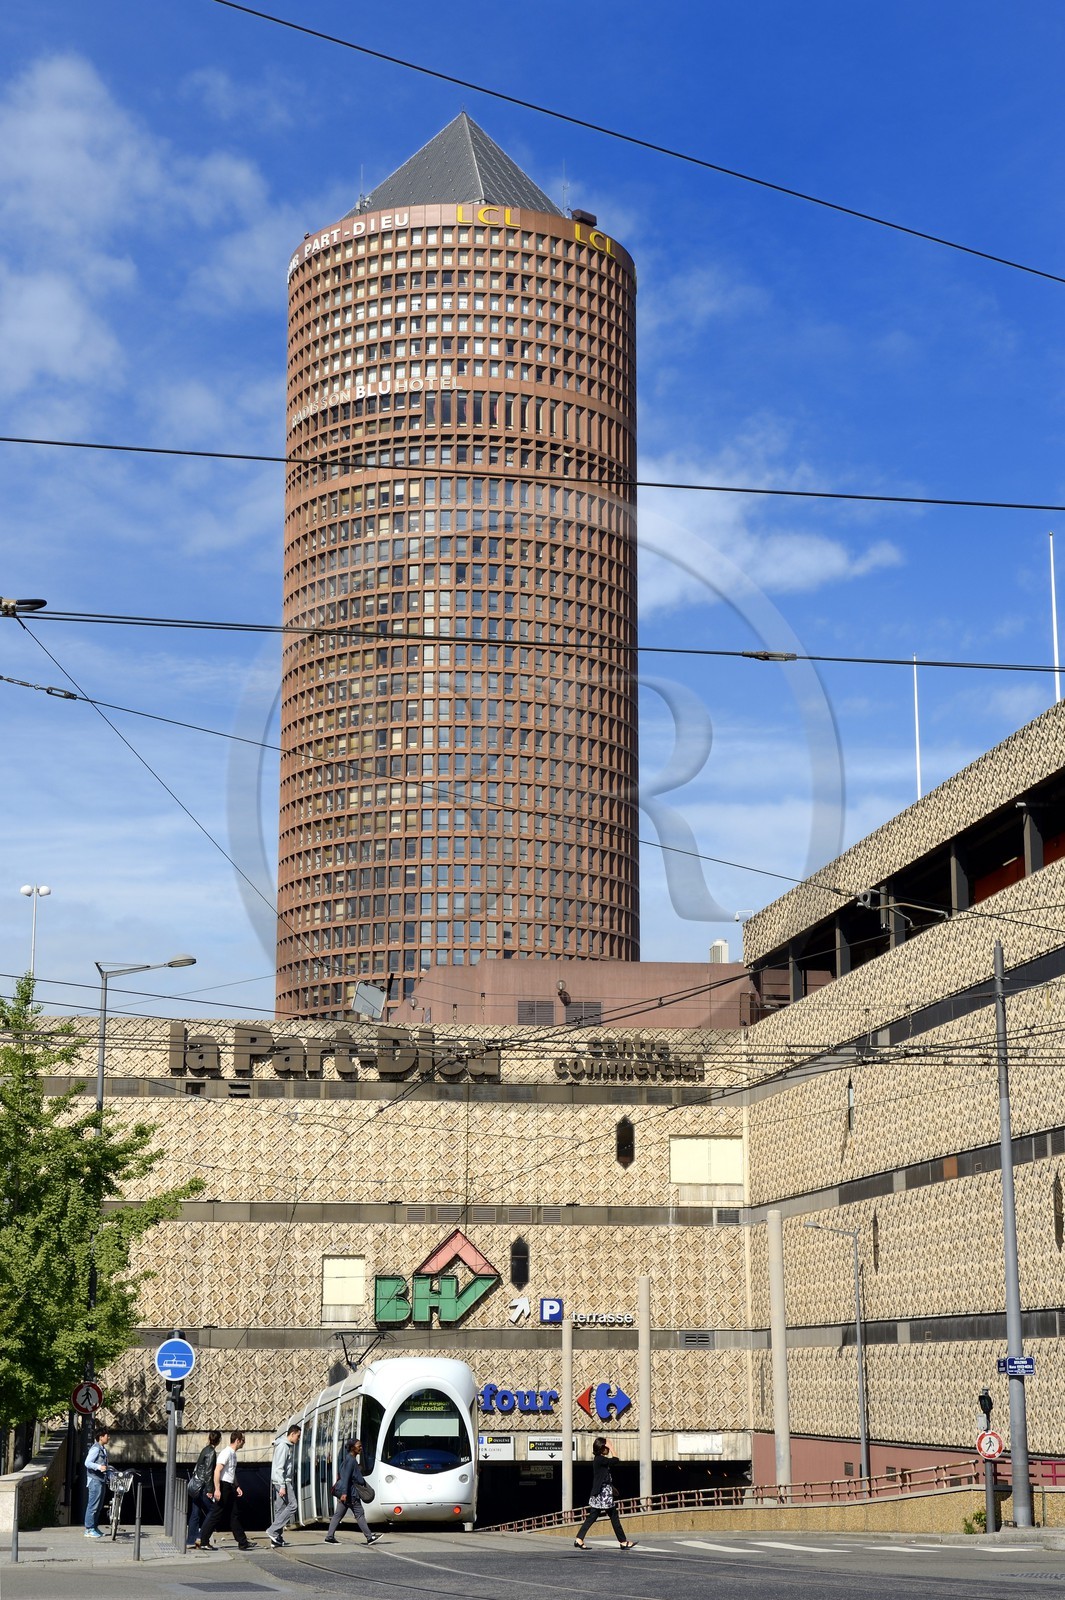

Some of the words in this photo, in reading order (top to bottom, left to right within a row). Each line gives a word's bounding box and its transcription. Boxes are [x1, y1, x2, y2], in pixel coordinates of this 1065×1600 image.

[457, 205, 520, 227] LCL
[304, 213, 409, 259] PART-DIEU
[575, 223, 616, 259] LCL
[291, 391, 350, 428] RADISSON
[355, 381, 391, 400] BLU
[394, 376, 463, 393] HOTEL
[170, 1022, 219, 1071] la
[553, 1055, 705, 1082] commercial
[375, 1274, 499, 1322] BHV
[543, 1300, 560, 1320] P
[572, 1311, 634, 1323] terrasse
[476, 1383, 559, 1412] four
